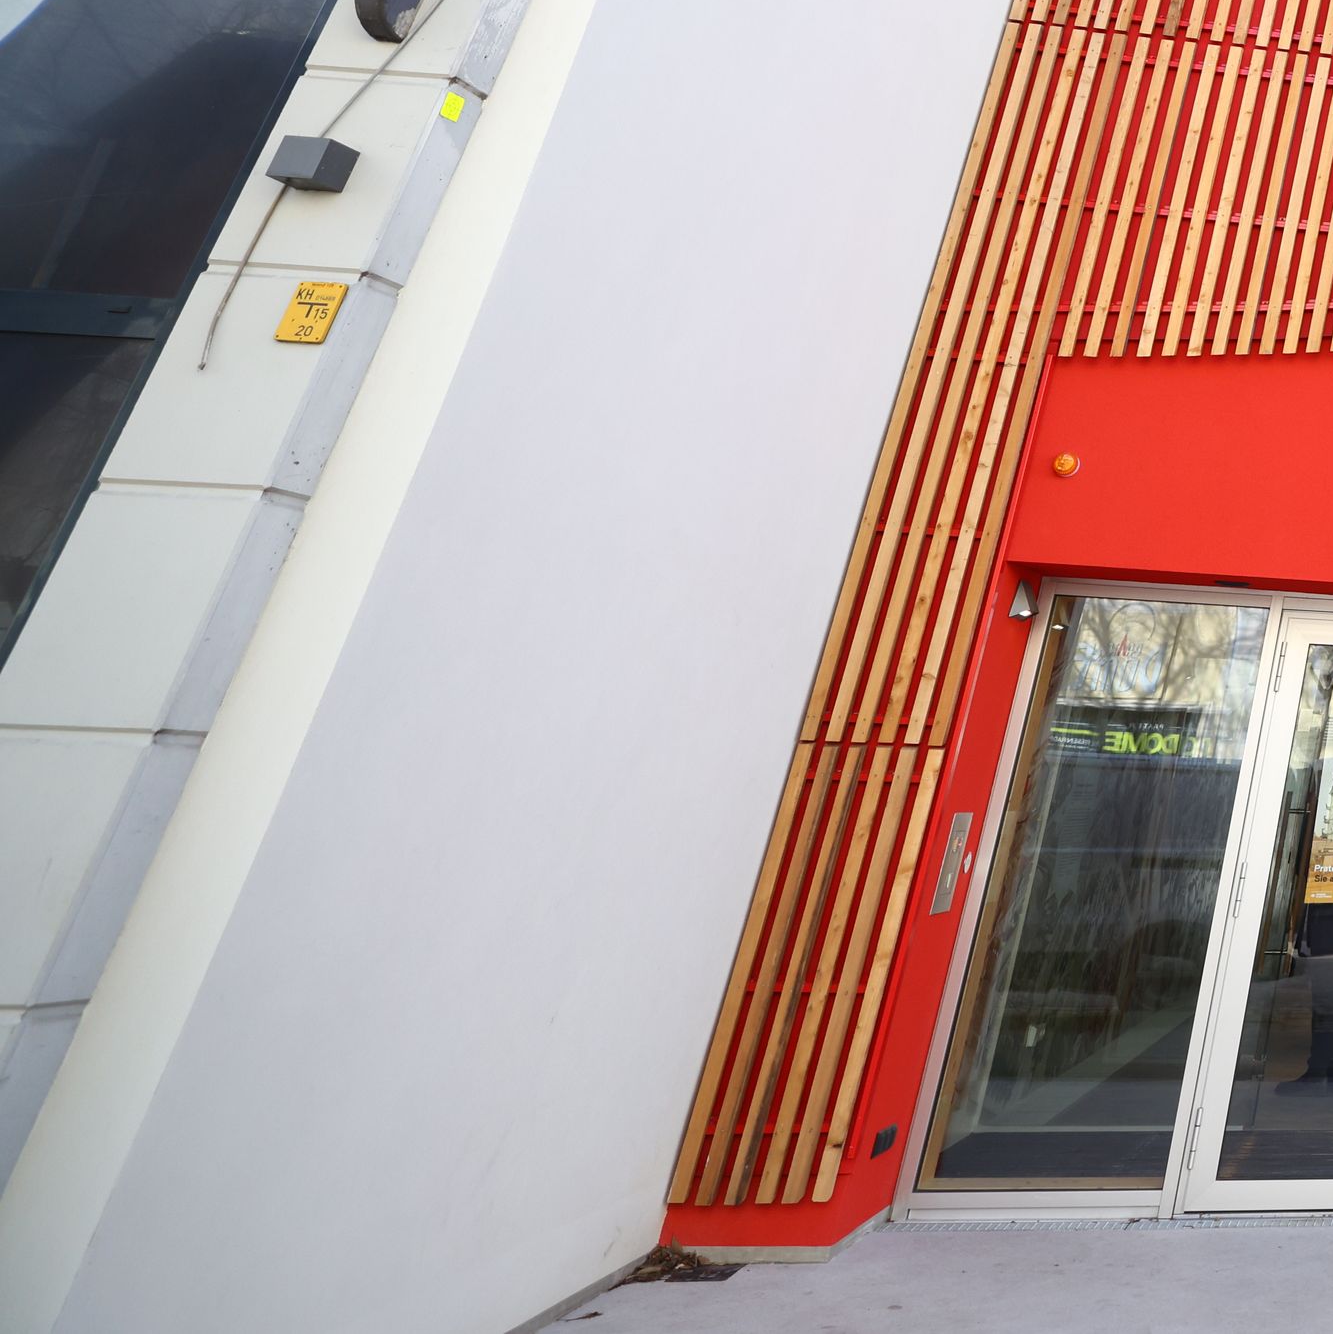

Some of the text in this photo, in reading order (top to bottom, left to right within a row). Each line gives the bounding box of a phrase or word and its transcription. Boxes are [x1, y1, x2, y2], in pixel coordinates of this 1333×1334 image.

[296, 288, 315, 300] KH
[314, 308, 329, 320] 15
[294, 324, 314, 337] 20
[1314, 874, 1328, 883] Sie
